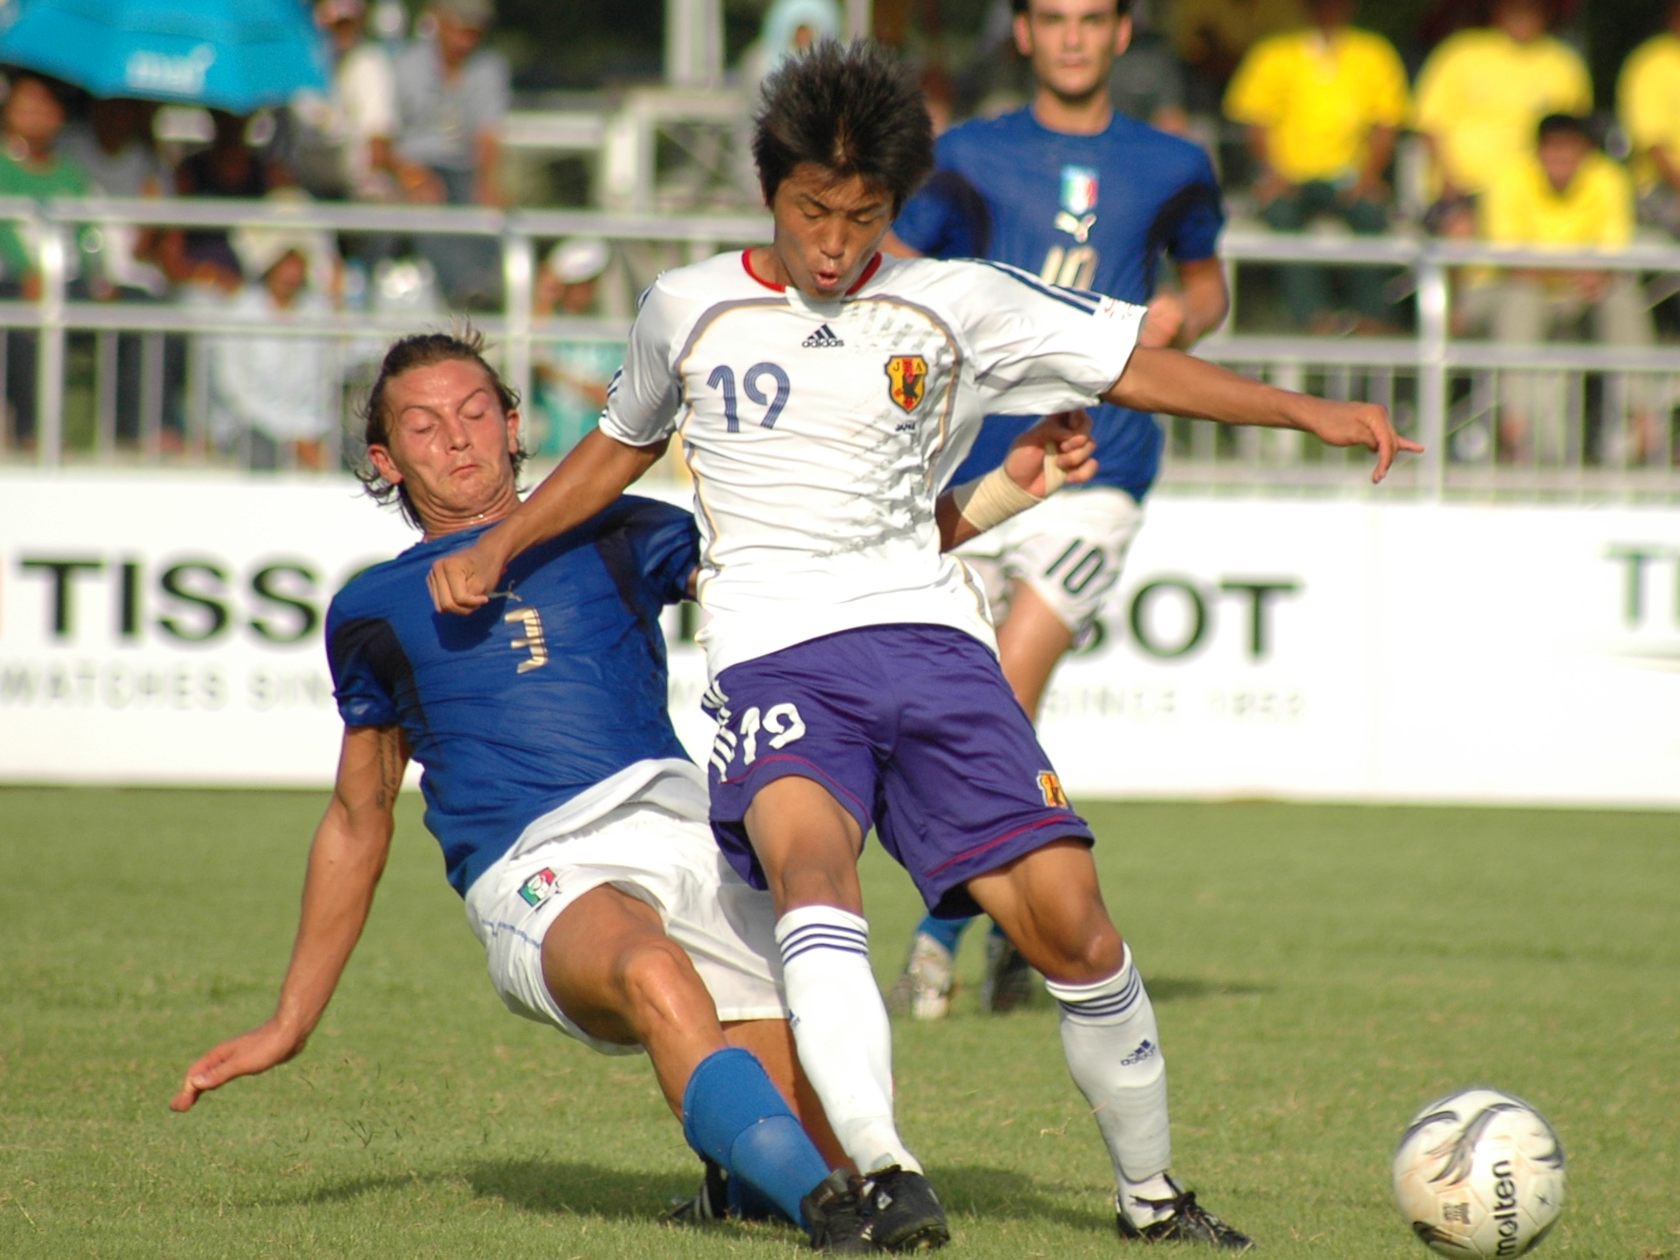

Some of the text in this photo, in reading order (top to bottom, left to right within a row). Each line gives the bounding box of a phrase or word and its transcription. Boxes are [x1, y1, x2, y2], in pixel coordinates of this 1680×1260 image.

[801, 338, 845, 348] adidas
[706, 361, 790, 433] 19
[17, 554, 394, 645] TISS
[1044, 538, 1104, 595] 10
[504, 607, 549, 673] 3
[740, 702, 806, 766] 19
[1492, 1160, 1519, 1256] molten
